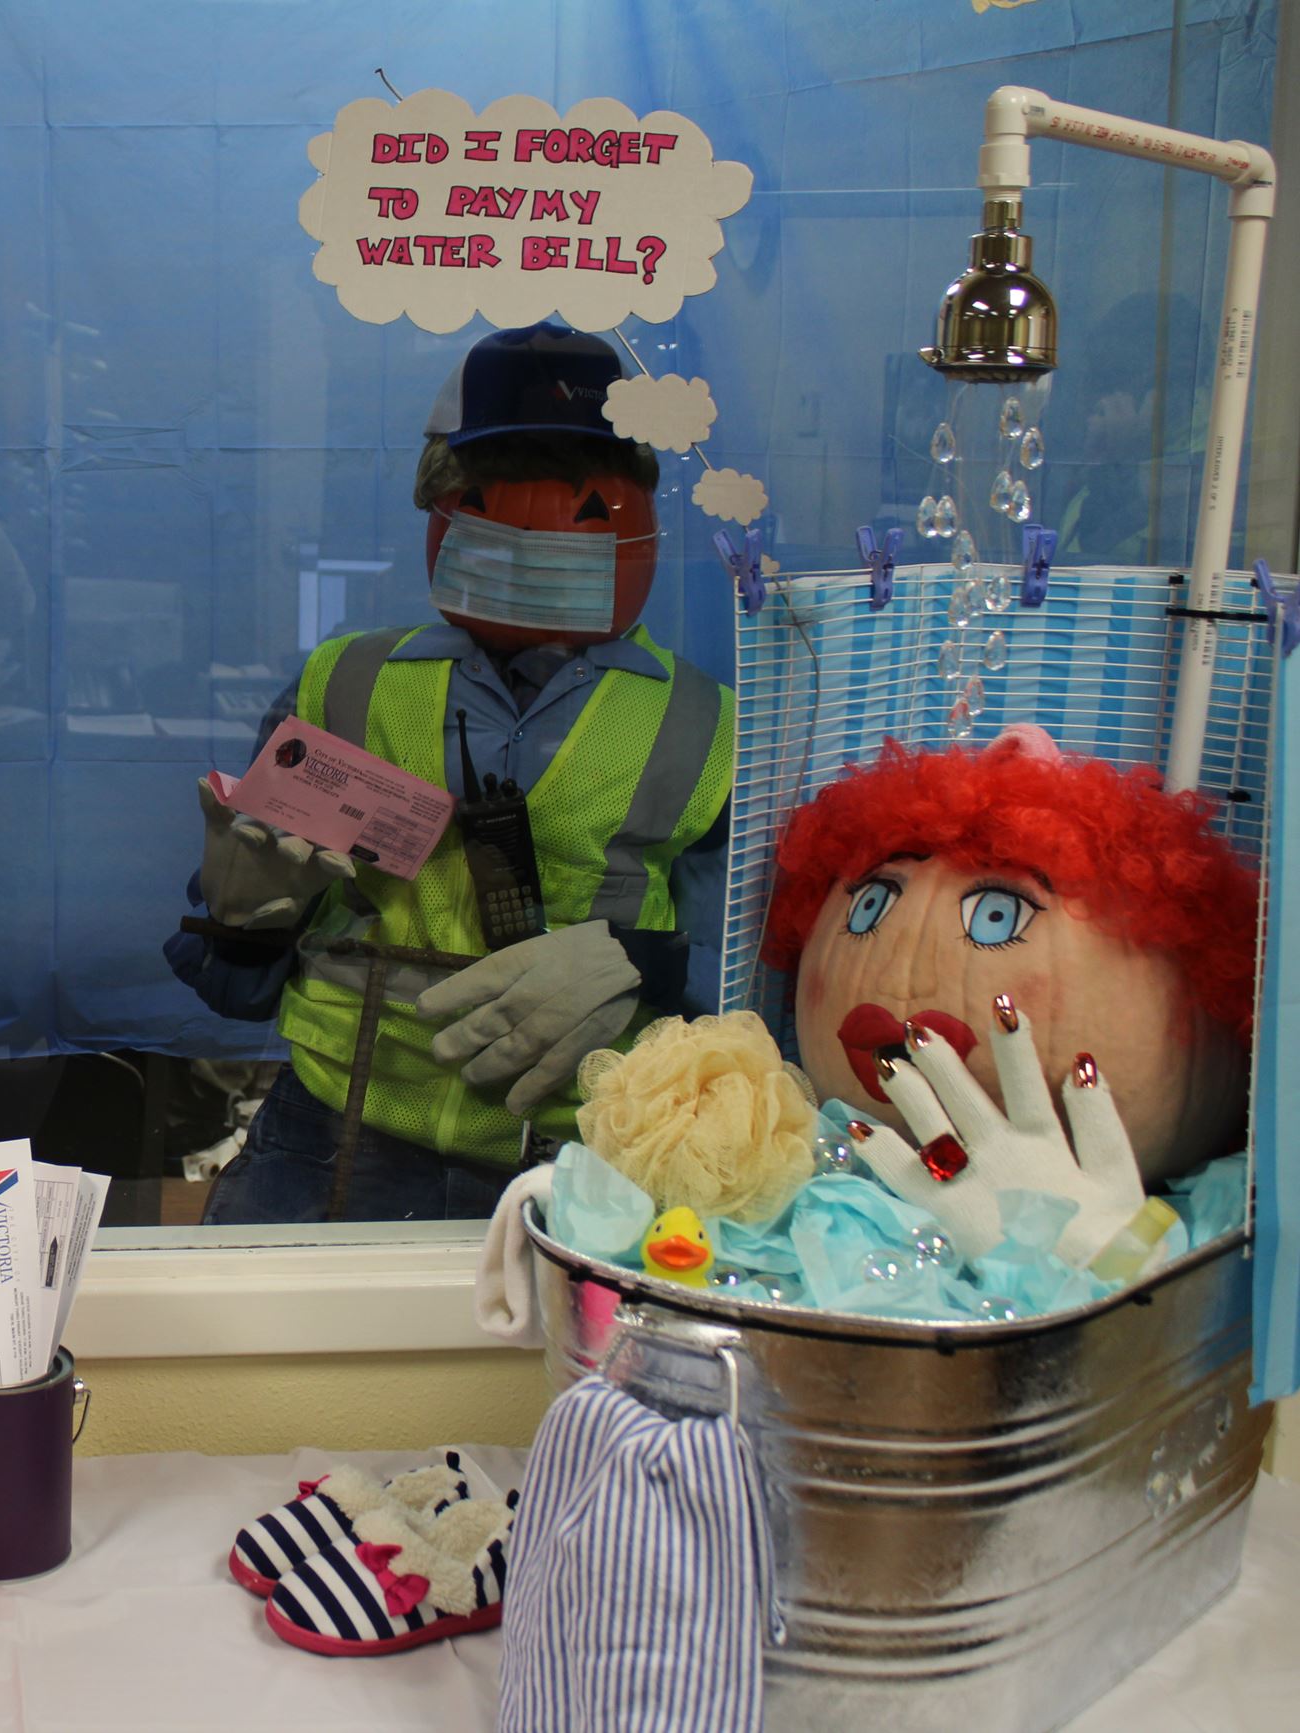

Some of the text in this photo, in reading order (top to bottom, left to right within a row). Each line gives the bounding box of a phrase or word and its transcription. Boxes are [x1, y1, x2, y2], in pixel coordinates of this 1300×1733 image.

[371, 127, 679, 169] DID I FORGET
[367, 186, 420, 220] TO
[356, 234, 667, 286] WATER BILL?
[305, 756, 349, 784] VICTORIA
